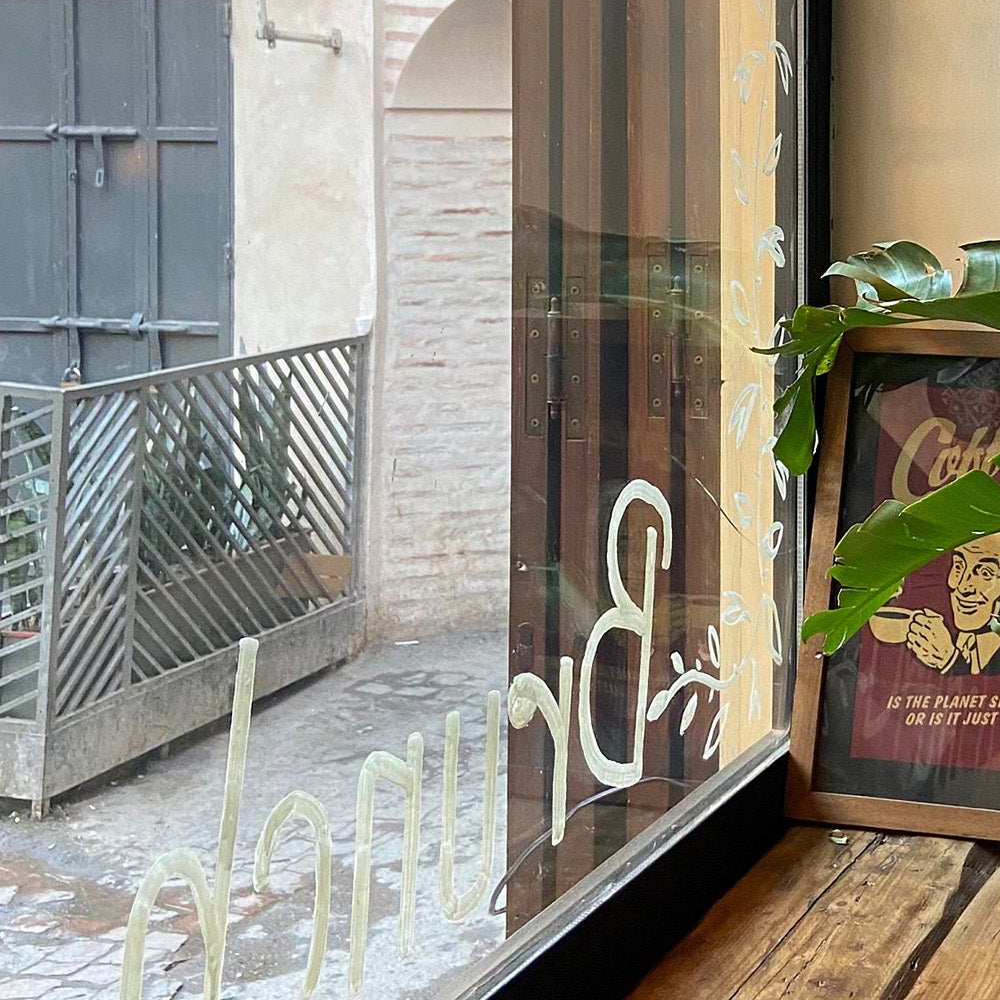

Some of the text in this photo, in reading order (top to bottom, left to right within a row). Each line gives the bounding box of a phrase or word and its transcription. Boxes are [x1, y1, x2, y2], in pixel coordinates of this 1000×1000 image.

[886, 695, 901, 709] IS
[905, 695, 931, 709] THE
[933, 694, 987, 709] PLANET
[905, 712, 926, 726] OR
[928, 712, 944, 726] IS
[946, 711, 961, 725] IT
[962, 711, 999, 725] JUST
